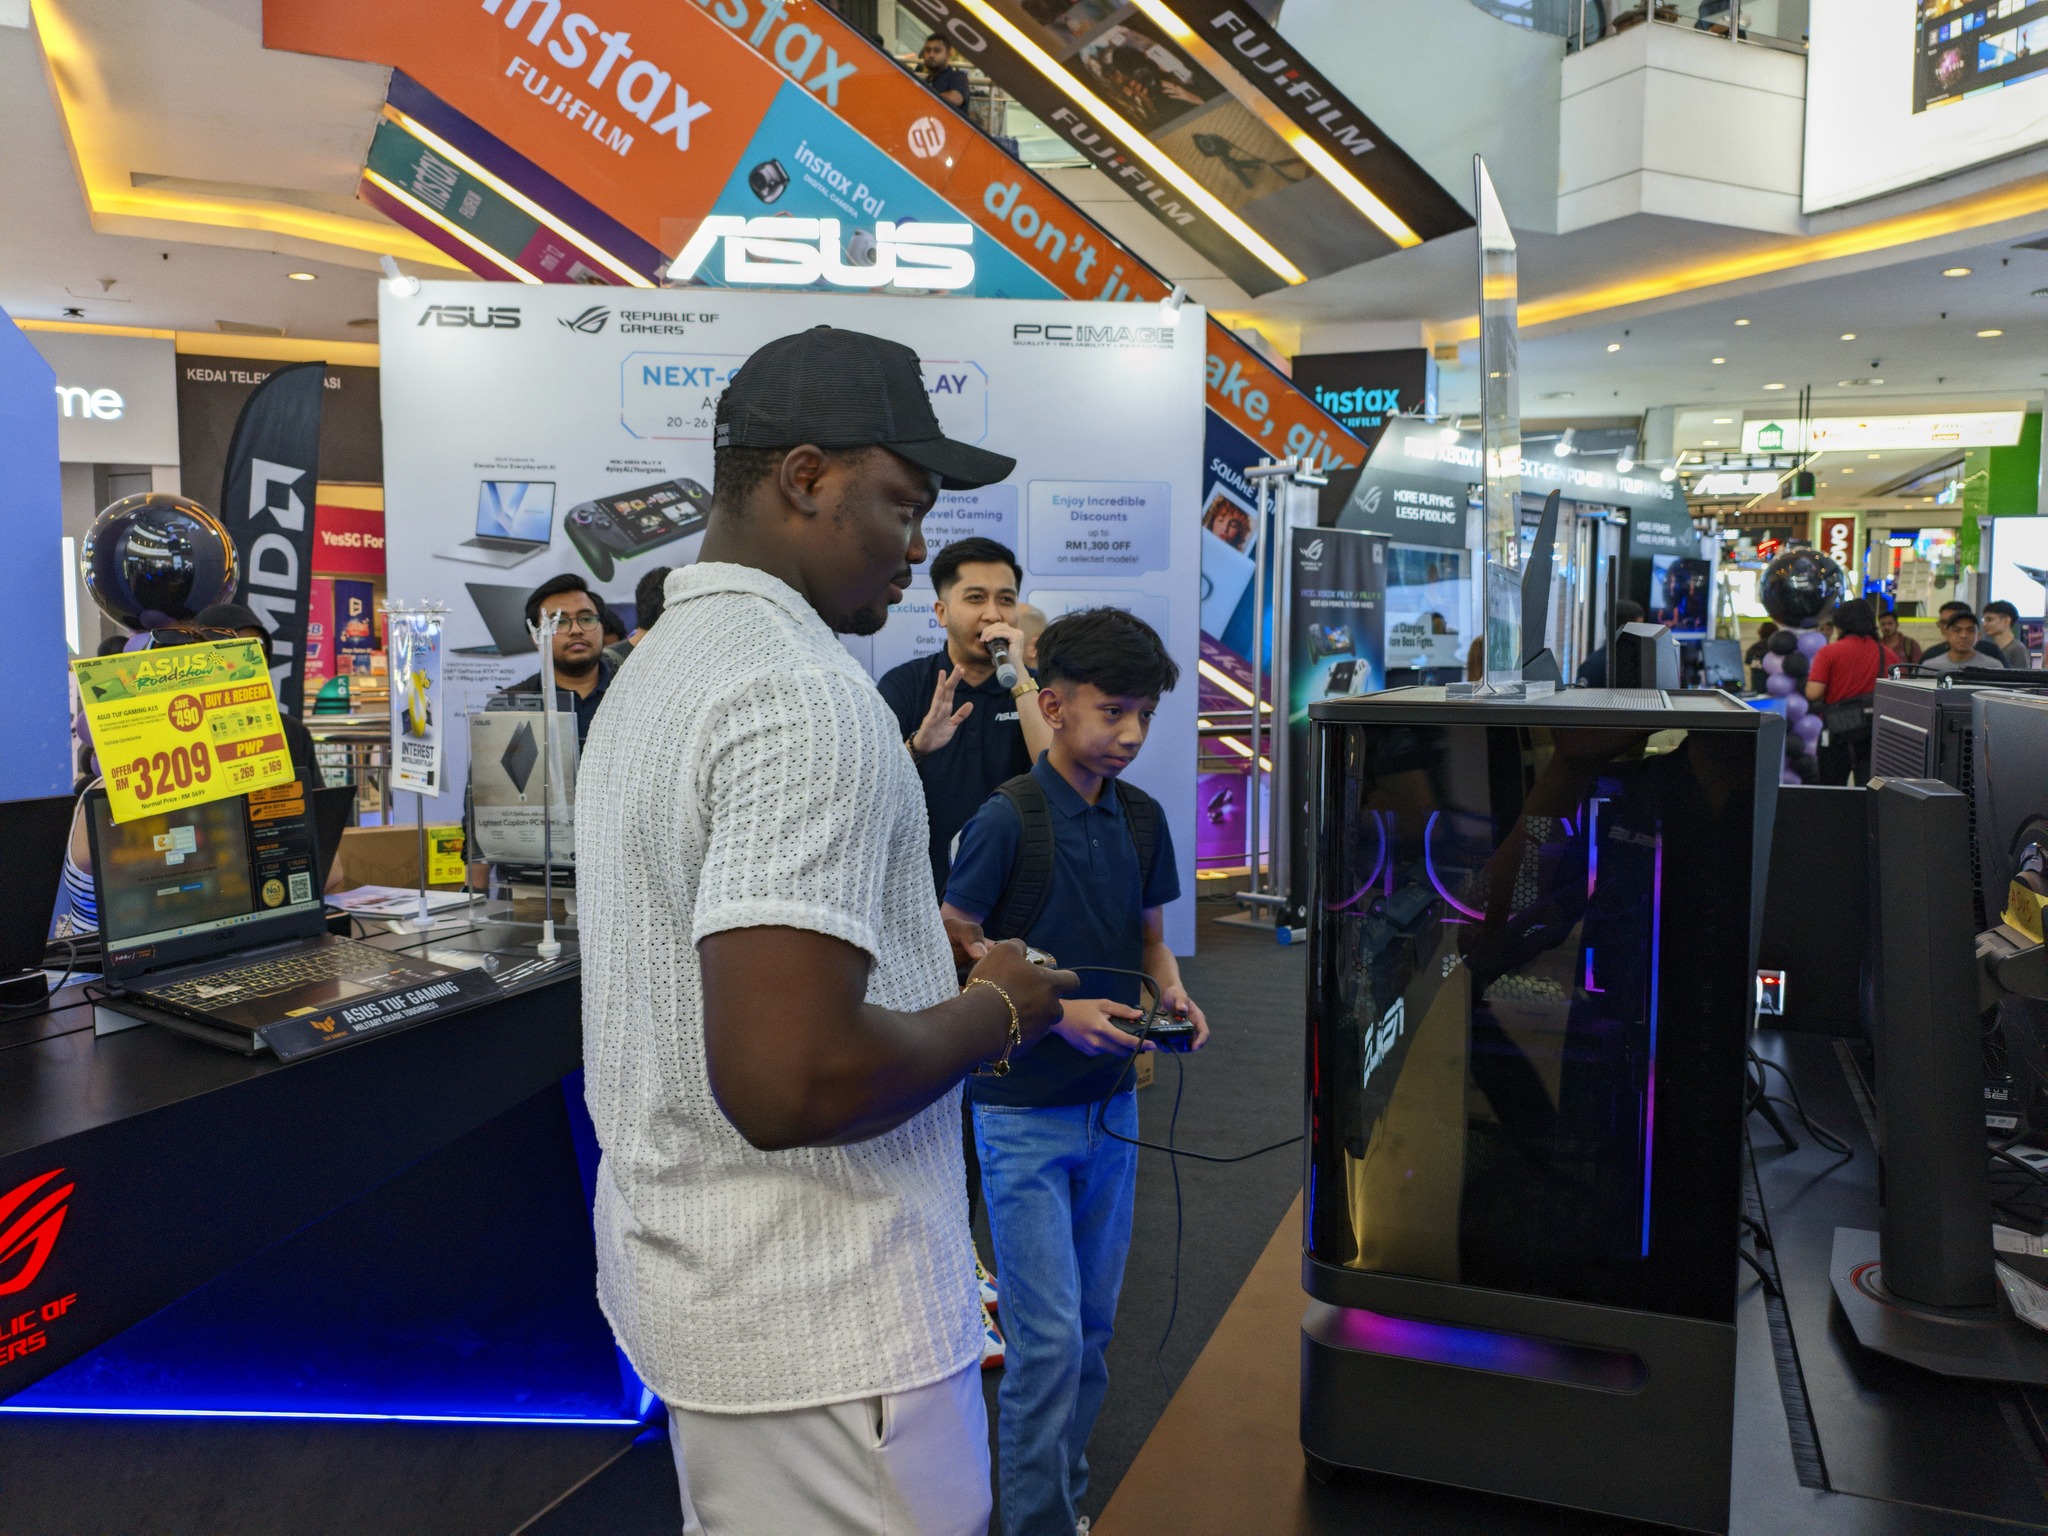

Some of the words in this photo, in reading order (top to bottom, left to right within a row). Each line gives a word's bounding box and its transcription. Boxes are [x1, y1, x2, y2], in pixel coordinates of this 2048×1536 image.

[701, 0, 858, 106] stax
[481, 0, 711, 152] nstax
[1210, 10, 1376, 157] FUJIFILM
[505, 55, 636, 157] FUJIFILM
[1051, 107, 1195, 227] FUJIFILM
[794, 140, 852, 192] instax
[851, 183, 886, 219] Pal
[666, 215, 976, 288] ASUS
[417, 304, 521, 329] ASUS
[620, 310, 696, 323] REPUBLIC
[699, 312, 720, 324] OF
[620, 323, 685, 335] GAMERS
[186, 368, 227, 383] KEDAI
[929, 374, 968, 395] AY
[1315, 385, 1400, 415] instax
[667, 416, 683, 428] 20
[694, 417, 709, 429] 26
[1437, 443, 1476, 468] XBOX
[1520, 461, 1567, 482] EXT-GEN
[1052, 495, 1085, 508] Enjoy
[1087, 496, 1146, 507] Incredible
[1394, 489, 1418, 504] MORE
[956, 508, 1003, 523] Gaming
[1070, 511, 1128, 522] Discounts
[1395, 505, 1419, 520] LESS
[936, 526, 949, 535] the
[951, 526, 975, 535] latest
[1088, 530, 1099, 538] up
[1100, 529, 1109, 537] to
[364, 532, 384, 549] For
[1065, 541, 1109, 552] RM1,300
[1111, 541, 1132, 551] OFF
[1829, 523, 1848, 570] OVO
[1070, 554, 1105, 563] selected
[1106, 555, 1140, 564] models!
[916, 635, 936, 644] Grab
[1402, 636, 1415, 647] Boss
[135, 653, 208, 679] ASUS
[133, 665, 215, 691] Roadshow
[174, 698, 190, 710] SAVE
[205, 693, 222, 708] BUY
[223, 694, 231, 705] &
[232, 684, 269, 704] REDEEM
[97, 713, 112, 721] ASUS
[123, 707, 147, 716] GAMING
[176, 706, 200, 728] 490
[995, 712, 1020, 721] ASUS
[236, 738, 264, 757] PWP
[402, 741, 435, 761] INTEREST
[111, 763, 133, 779] OFFER
[132, 737, 212, 801] 3209
[240, 765, 255, 780] 269
[268, 759, 282, 773] 169
[115, 777, 130, 791] RM
[140, 799, 162, 811] Normal
[162, 795, 178, 806] Price
[181, 792, 191, 801] RM
[191, 789, 206, 798] 3699
[478, 820, 503, 828] Lightest
[504, 819, 529, 828] Copilot+
[342, 1001, 380, 1025] ASUS
[381, 995, 408, 1015] TUF
[408, 980, 461, 1007] GAMING
[352, 1014, 383, 1033] MILITARY
[382, 1010, 403, 1026] GRADE
[402, 1001, 440, 1021] TOUGHNESS
[41, 1293, 77, 1322] OF
